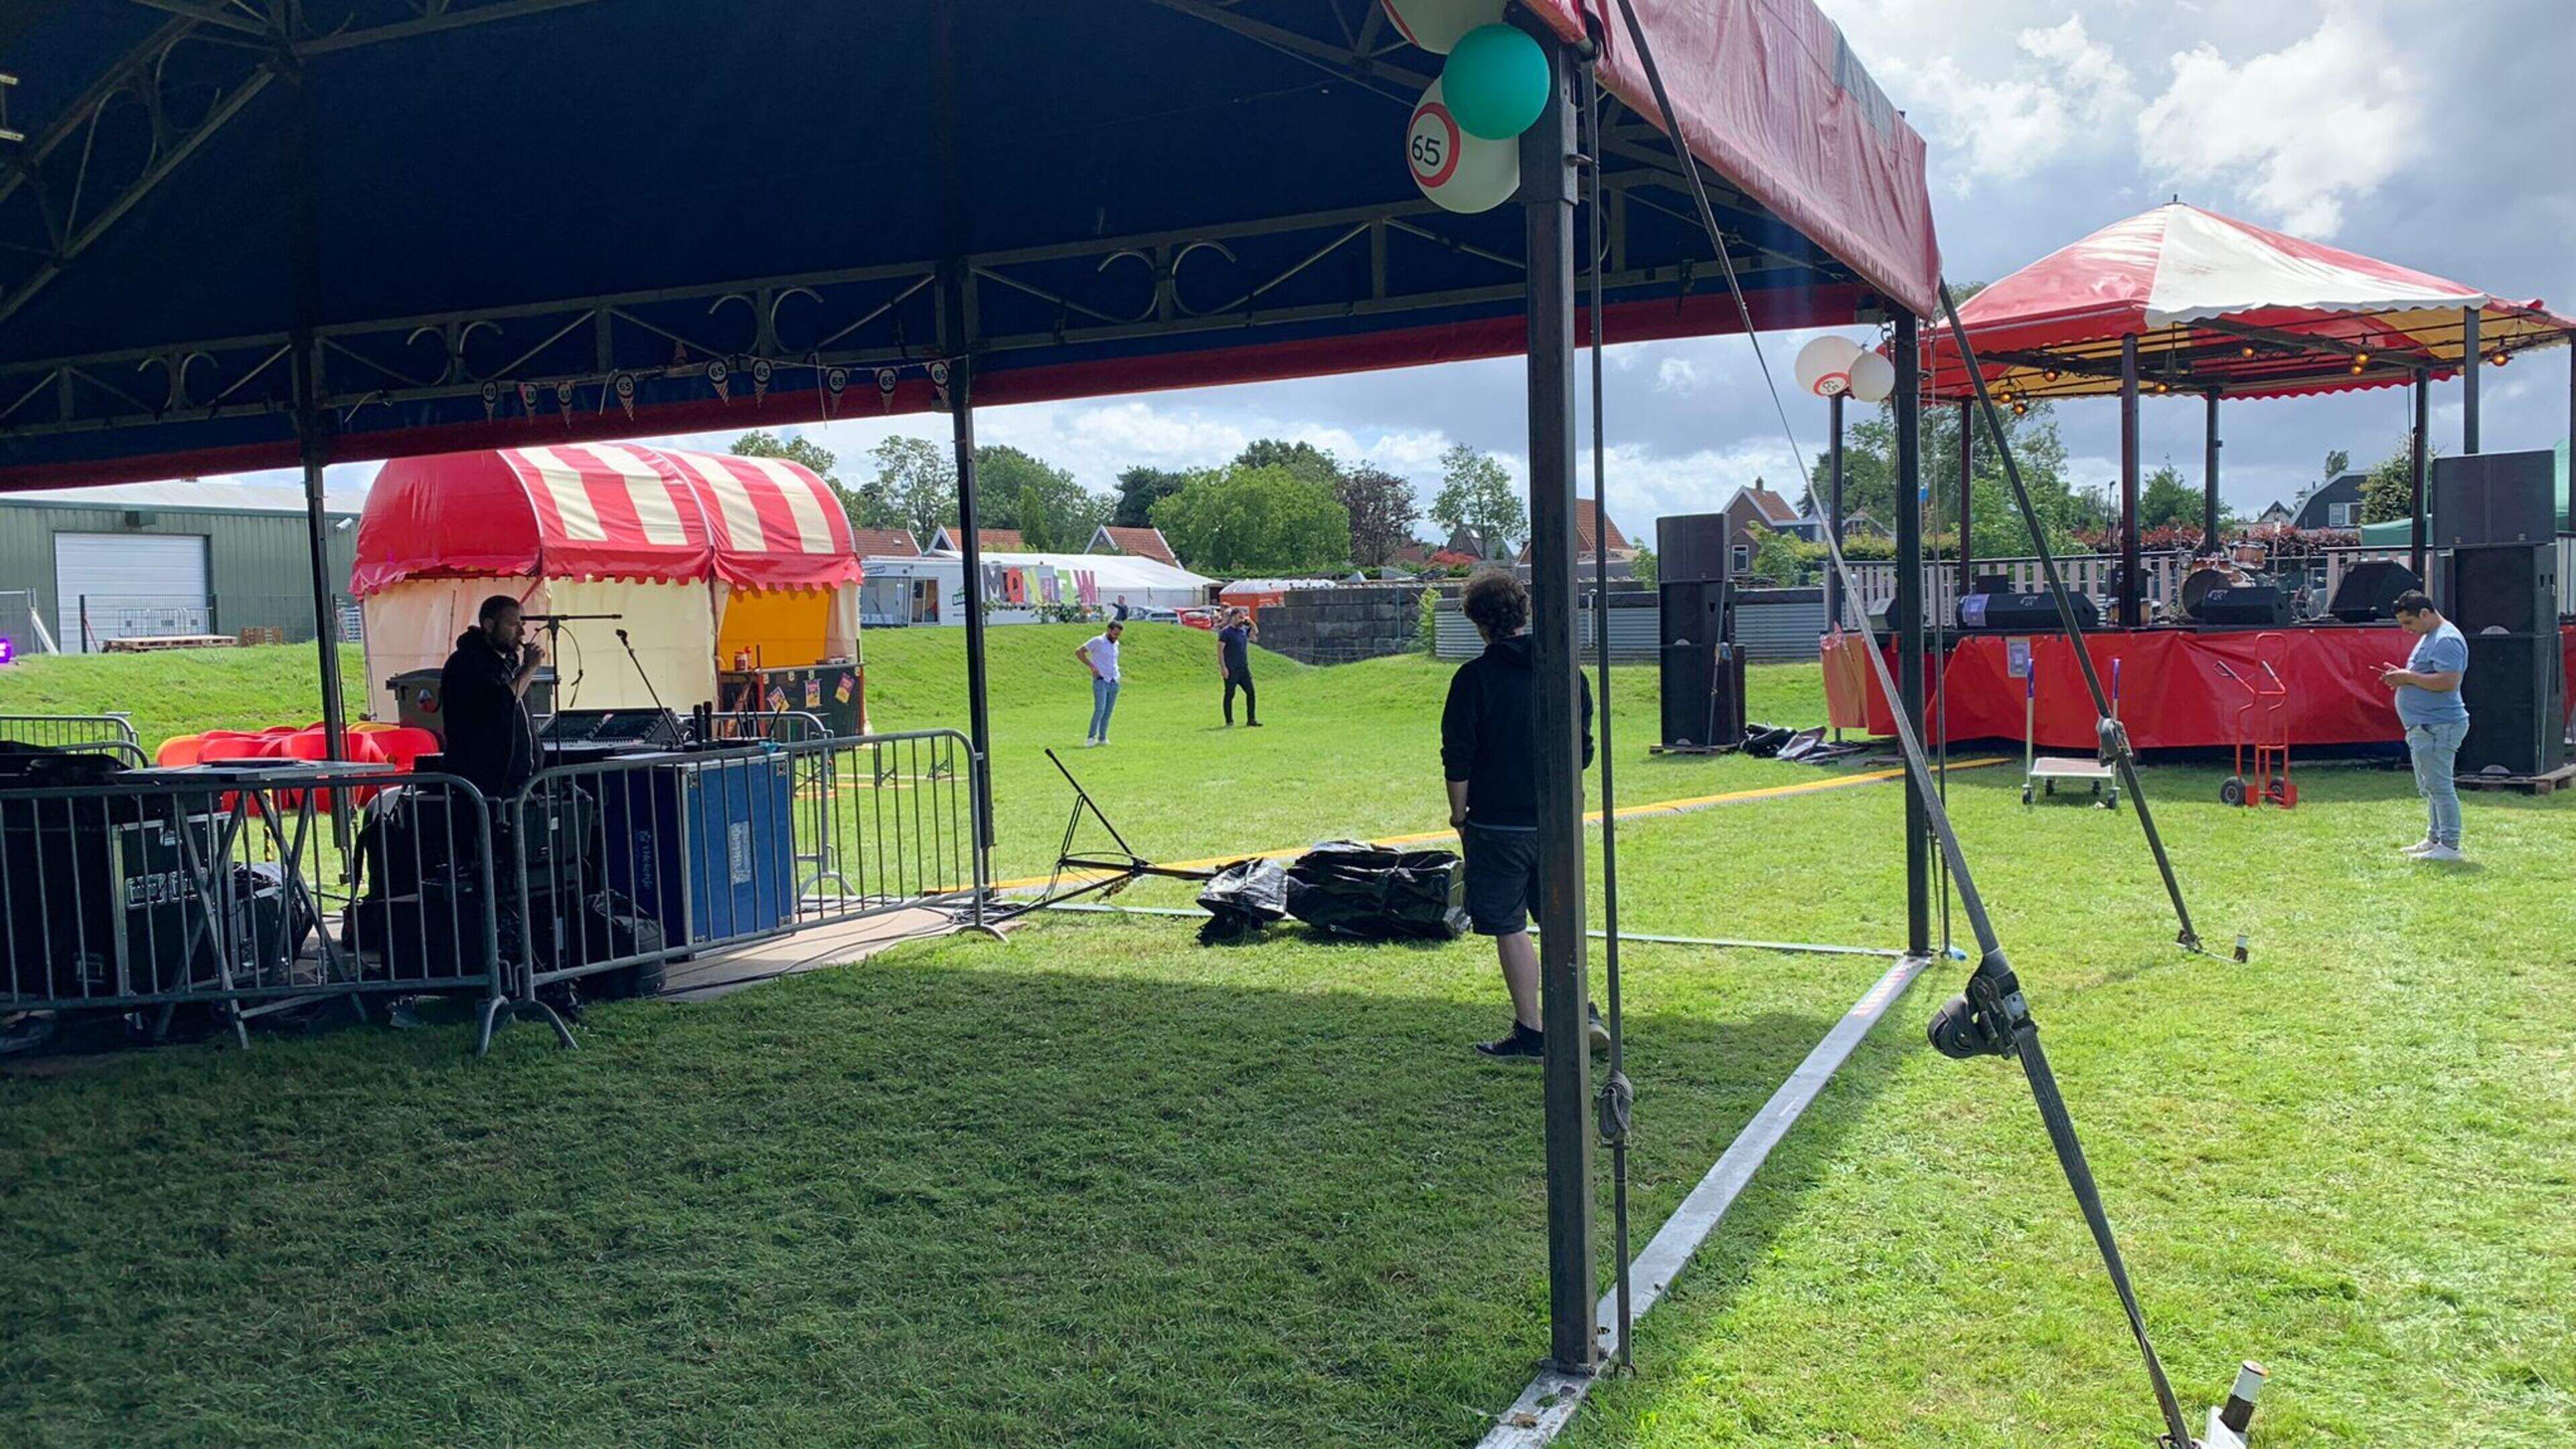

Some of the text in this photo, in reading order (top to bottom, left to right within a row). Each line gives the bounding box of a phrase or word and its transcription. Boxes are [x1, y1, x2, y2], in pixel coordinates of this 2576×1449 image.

[1411, 135, 1440, 166] 65
[710, 368, 726, 377] 65
[757, 367, 769, 377] 65
[933, 369, 947, 380] 65
[619, 381, 633, 391] 65
[832, 376, 845, 386] 65
[881, 376, 895, 386] 65
[1822, 380, 1840, 393] 65
